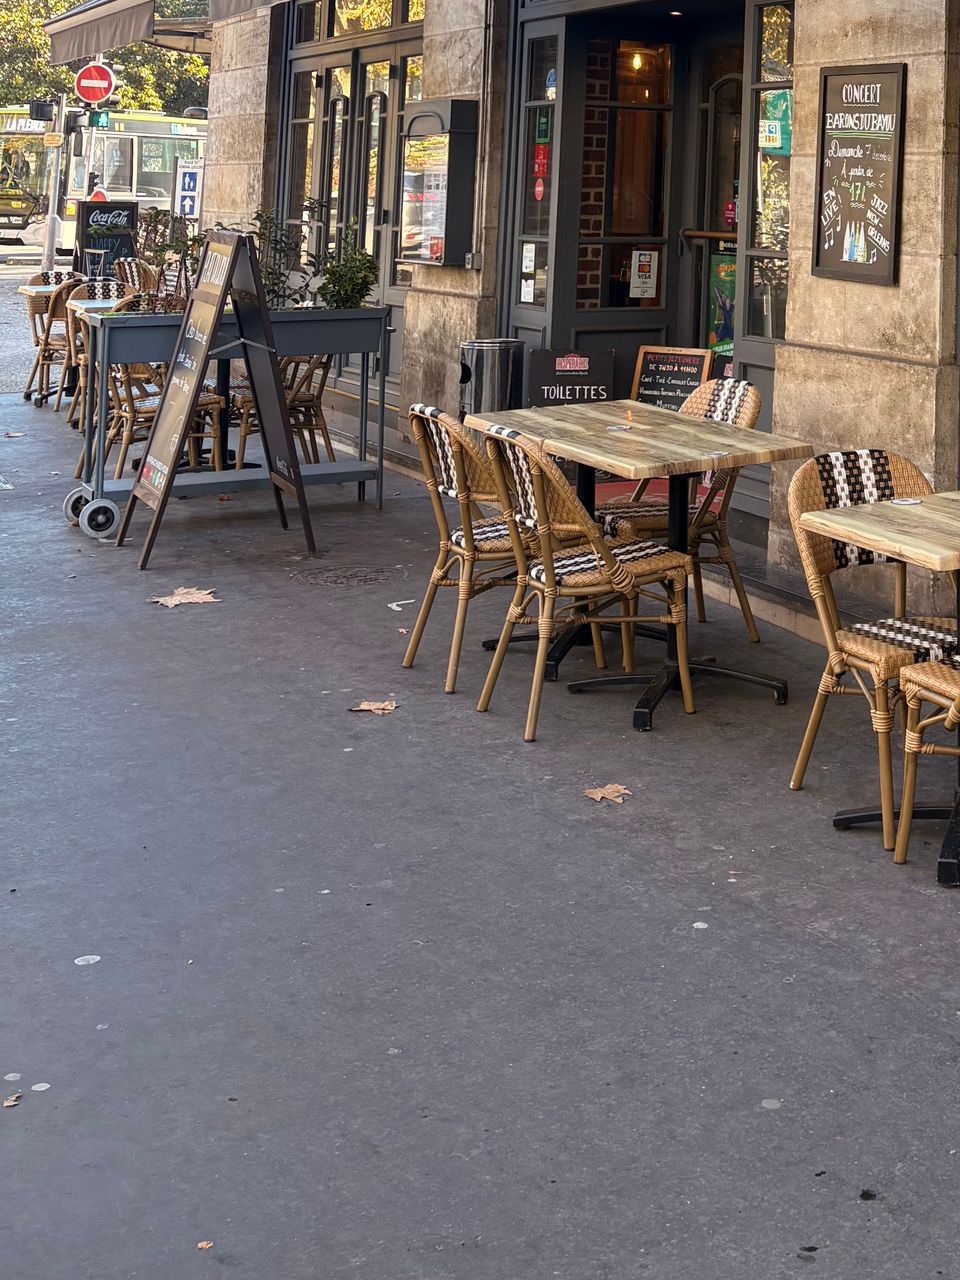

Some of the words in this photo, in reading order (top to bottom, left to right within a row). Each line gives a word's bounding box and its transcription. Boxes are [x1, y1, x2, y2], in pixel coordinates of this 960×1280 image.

[842, 84, 881, 103] CONCERT
[828, 139, 864, 158] Dimanche
[865, 144, 871, 158] 7
[823, 187, 836, 204] EN
[870, 194, 888, 215] JAZZ
